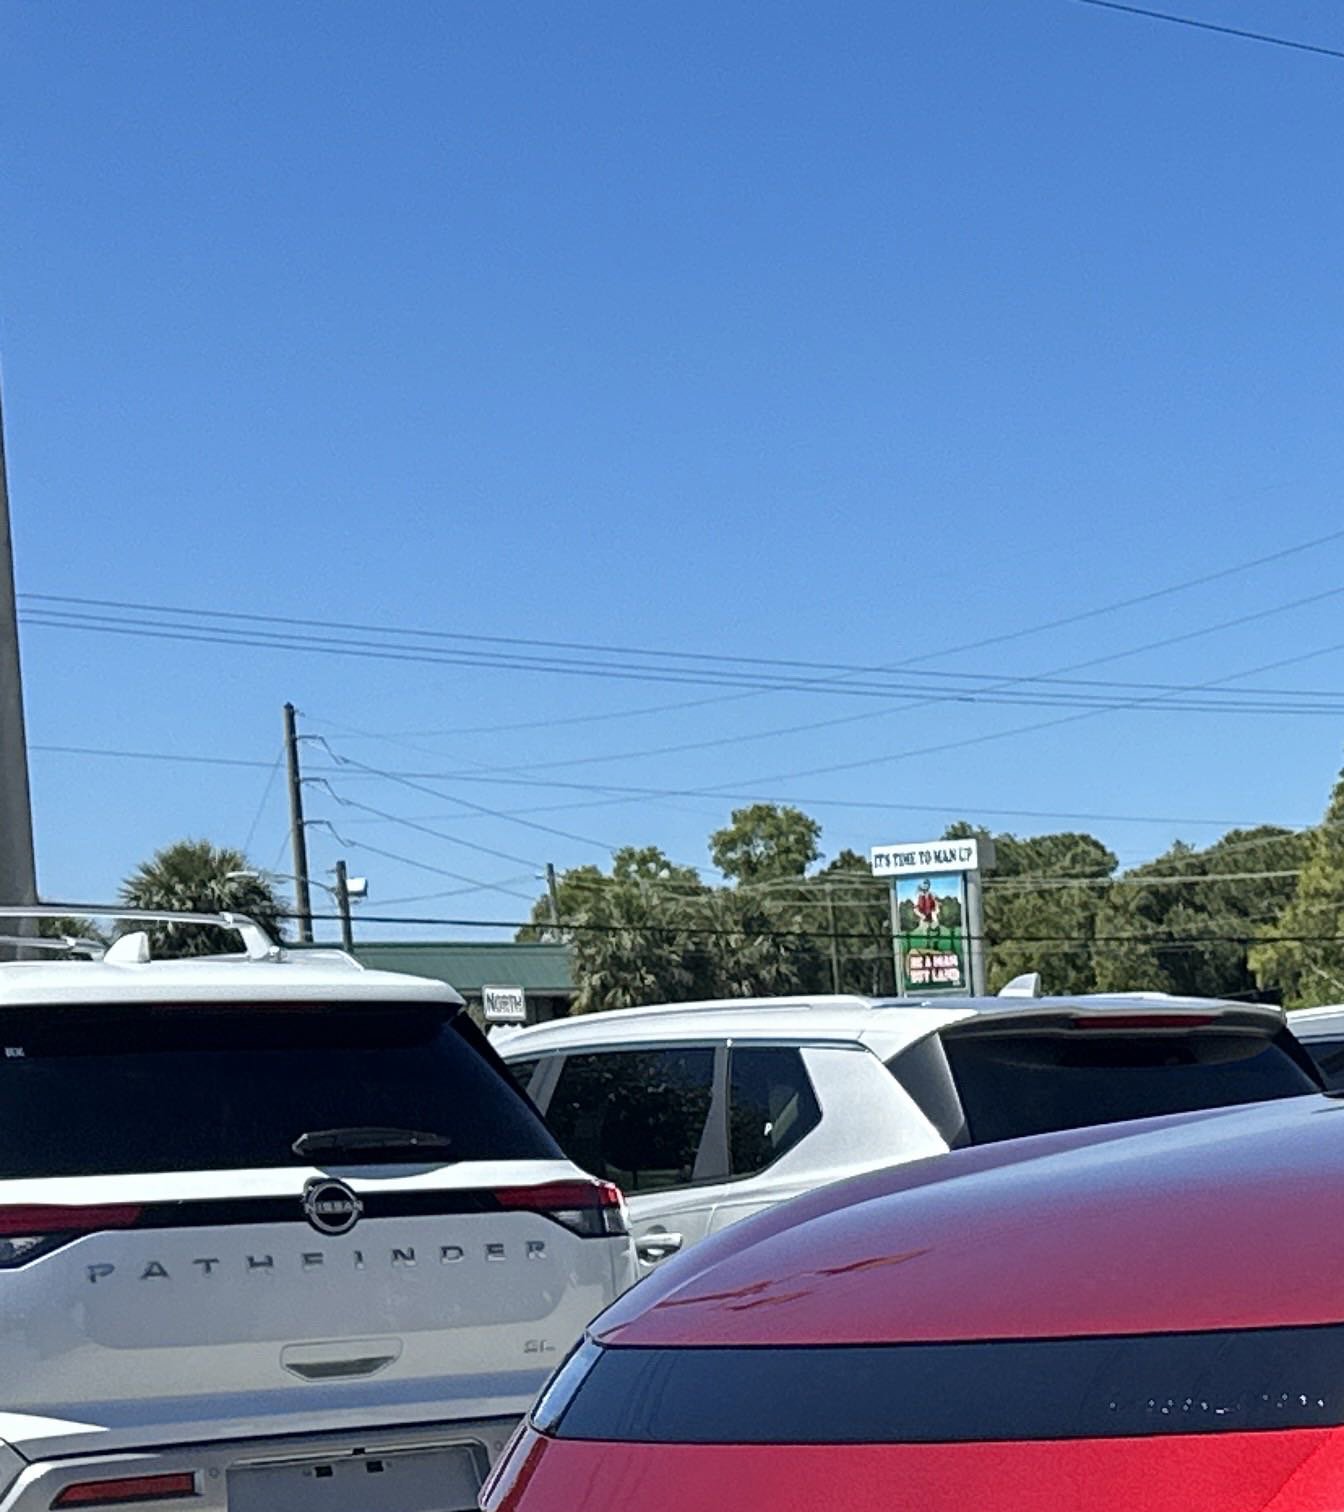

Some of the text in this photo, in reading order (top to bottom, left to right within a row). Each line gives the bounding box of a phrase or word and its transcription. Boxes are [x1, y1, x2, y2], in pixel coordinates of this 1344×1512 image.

[893, 852, 916, 867] TIME
[919, 851, 931, 865] TO
[934, 849, 957, 863] MAN
[959, 847, 973, 862] UP
[304, 1200, 364, 1214] NISSAN
[85, 1239, 548, 1285] PATHFINDER
